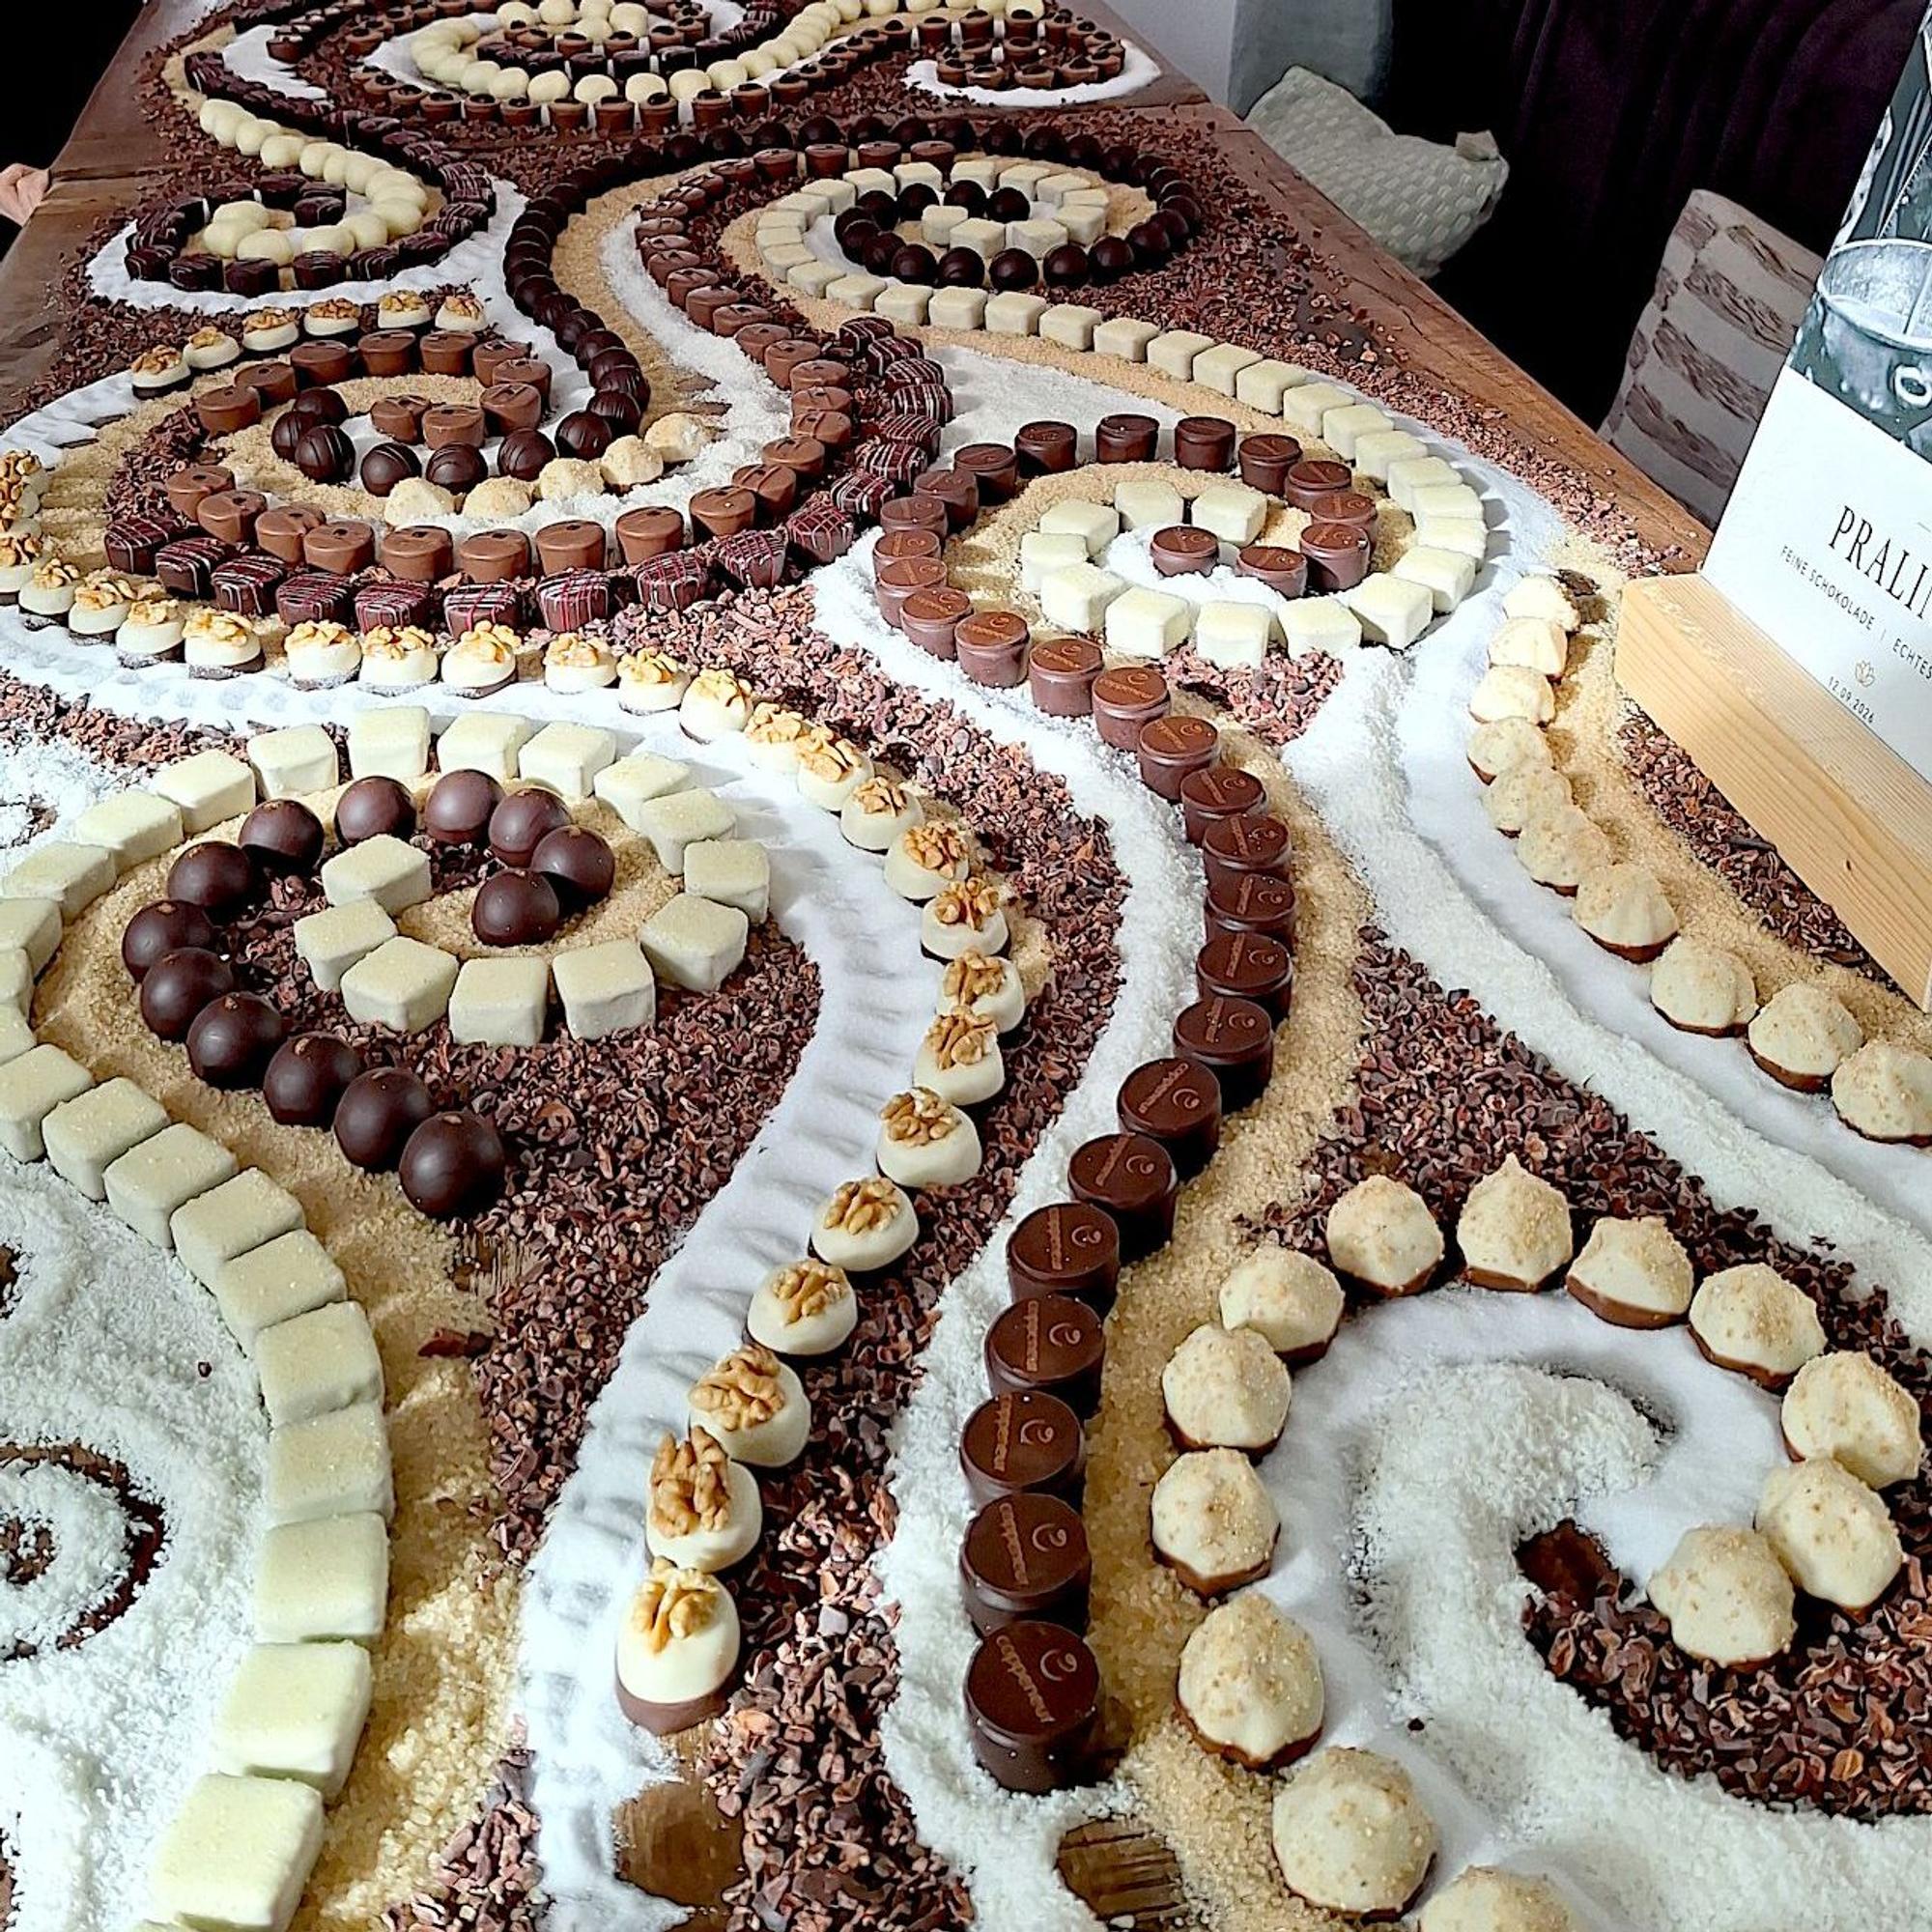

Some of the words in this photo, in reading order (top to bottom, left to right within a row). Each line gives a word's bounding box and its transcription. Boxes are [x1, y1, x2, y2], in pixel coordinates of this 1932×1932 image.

[1780, 545, 1808, 576] FEINE
[1808, 568, 1875, 631] SCHOKOLADE
[1829, 676, 1874, 724] 12.09.2026
[996, 1634, 1056, 1722] coppeneur
